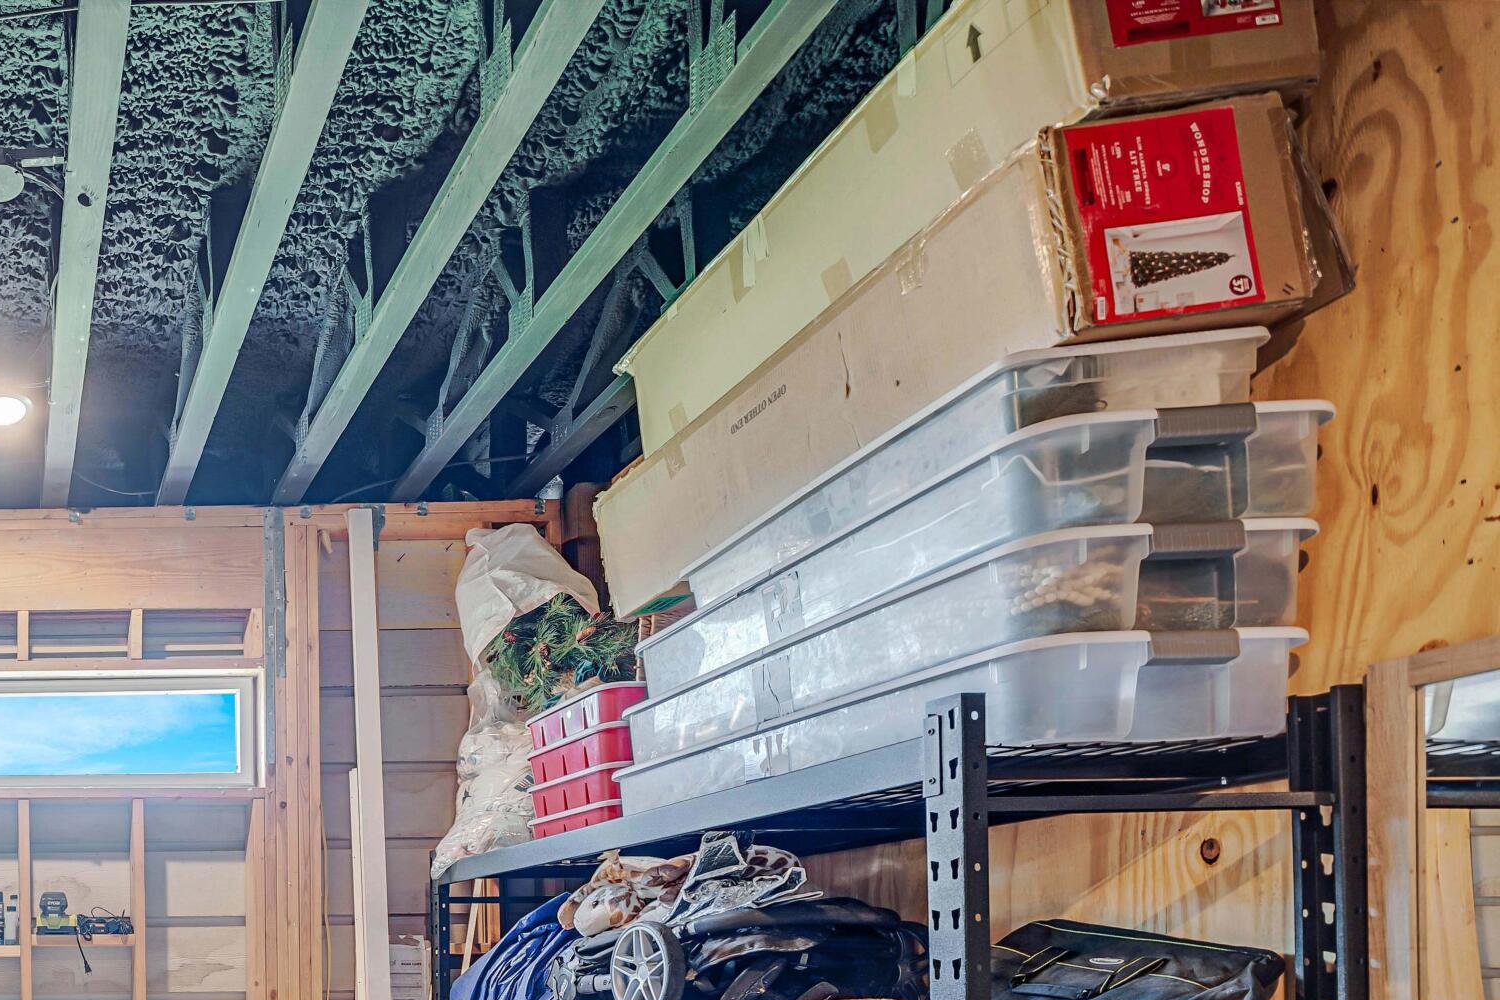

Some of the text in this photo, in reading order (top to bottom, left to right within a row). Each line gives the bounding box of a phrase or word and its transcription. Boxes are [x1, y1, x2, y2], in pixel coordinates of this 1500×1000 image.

[1129, 150, 1142, 193] LIT TREE
[1190, 121, 1211, 204] WONDERSHOP
[730, 384, 787, 435] OPEN OTHER END
